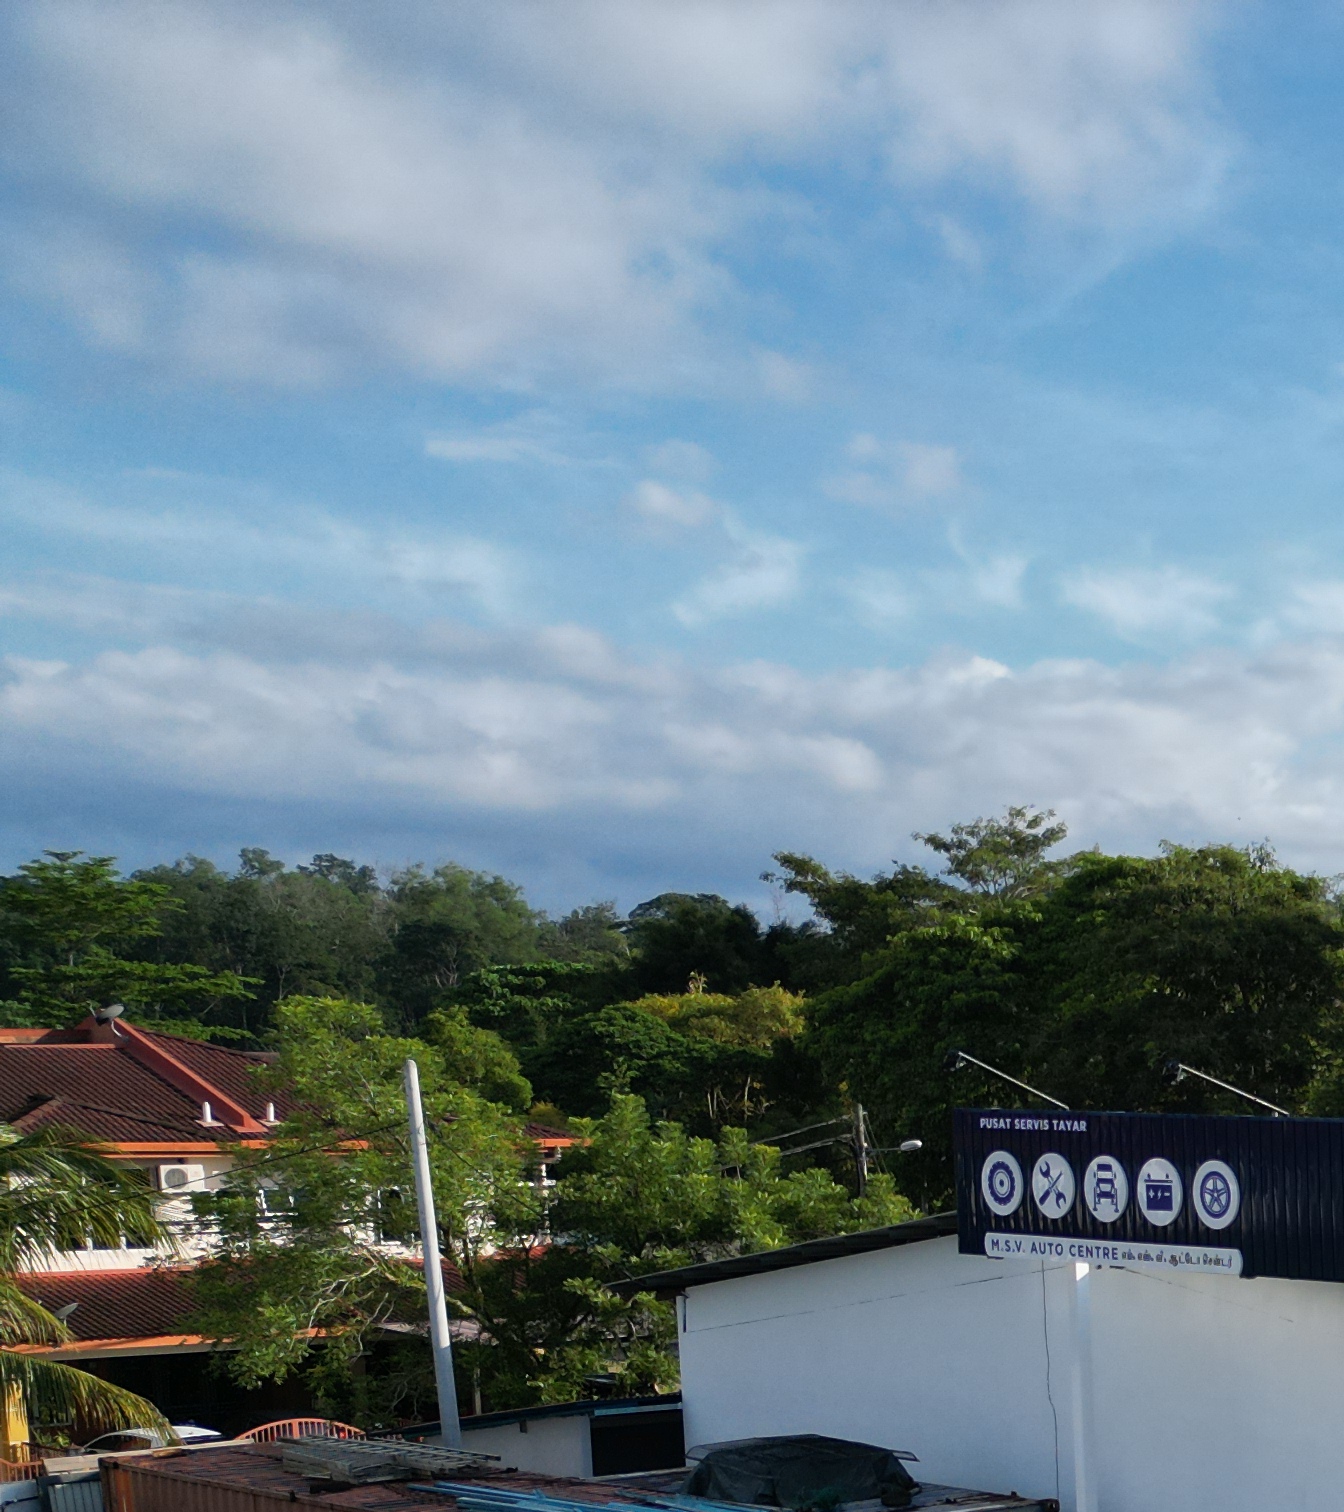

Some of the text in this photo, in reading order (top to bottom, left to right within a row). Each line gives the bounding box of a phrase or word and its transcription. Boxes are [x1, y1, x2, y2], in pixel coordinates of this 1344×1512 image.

[980, 1118, 1087, 1132] PUSAT SERVIS TAYAR
[991, 1239, 1118, 1260] M.S.V. AUTO CENTRE
